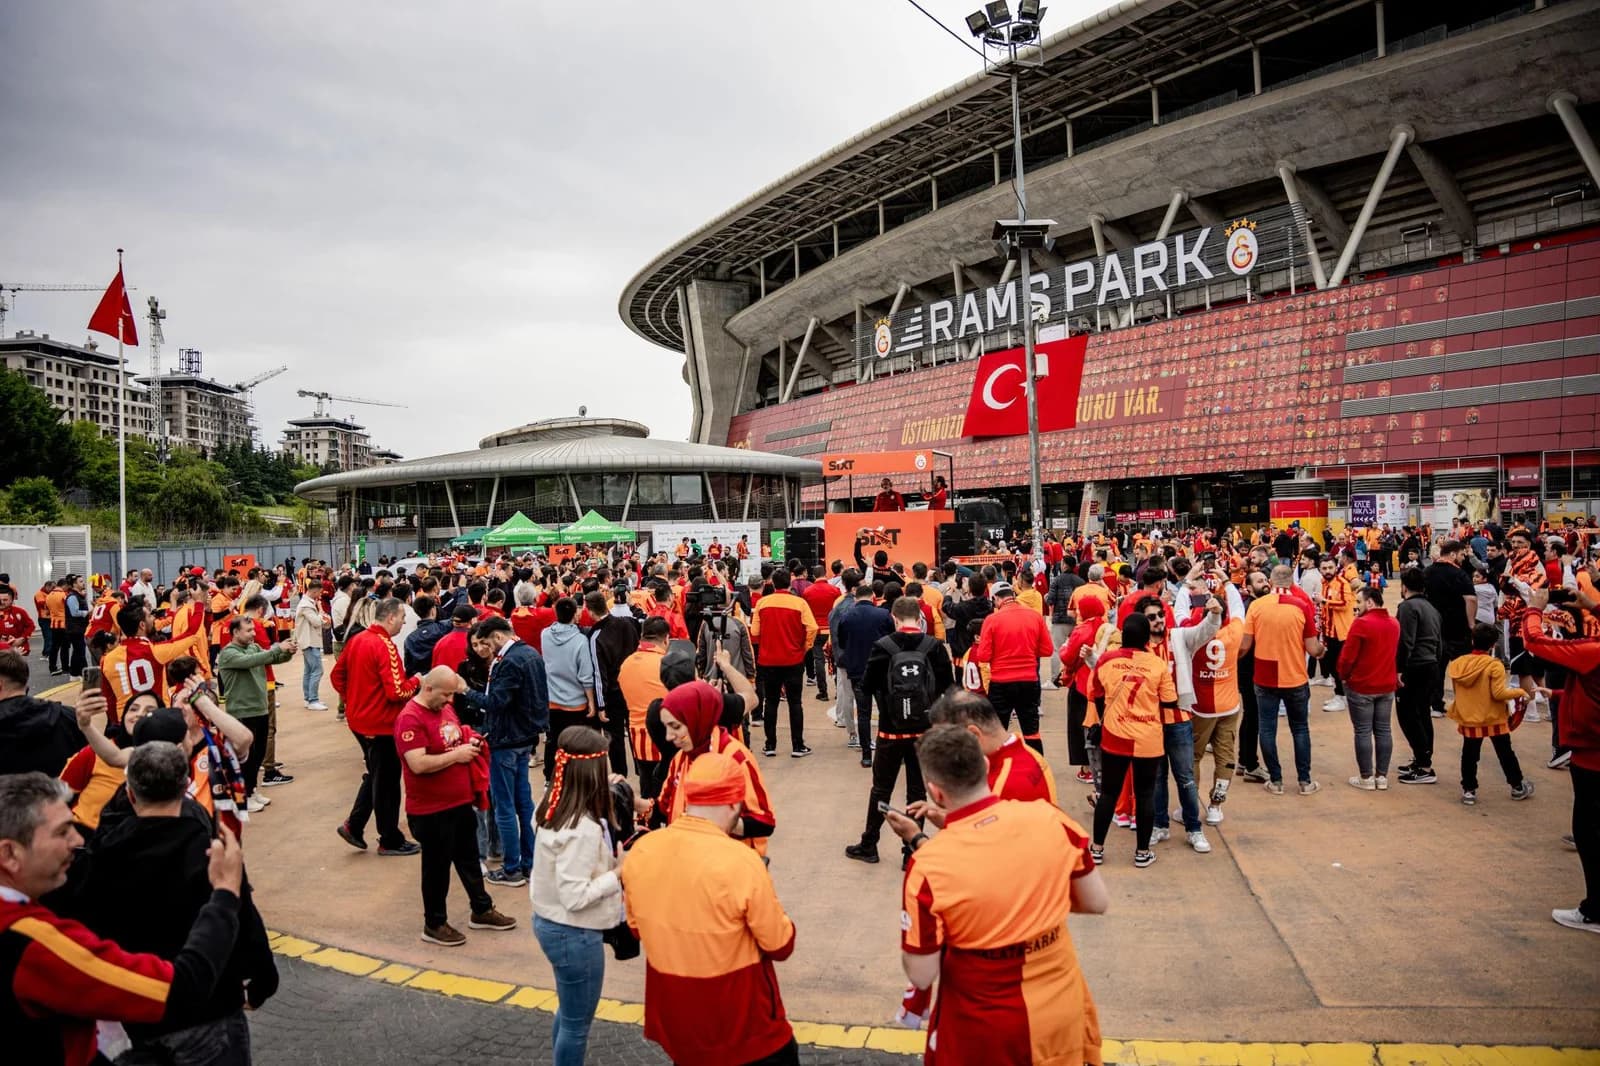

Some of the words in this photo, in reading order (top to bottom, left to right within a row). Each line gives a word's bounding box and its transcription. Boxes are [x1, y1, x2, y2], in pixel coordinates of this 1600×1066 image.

[930, 273, 1051, 344] RAMS
[1064, 228, 1214, 313] PARK
[1124, 386, 1163, 417] VAR.
[1206, 639, 1226, 671] 9
[114, 658, 155, 696] 10
[1122, 674, 1146, 708] 7
